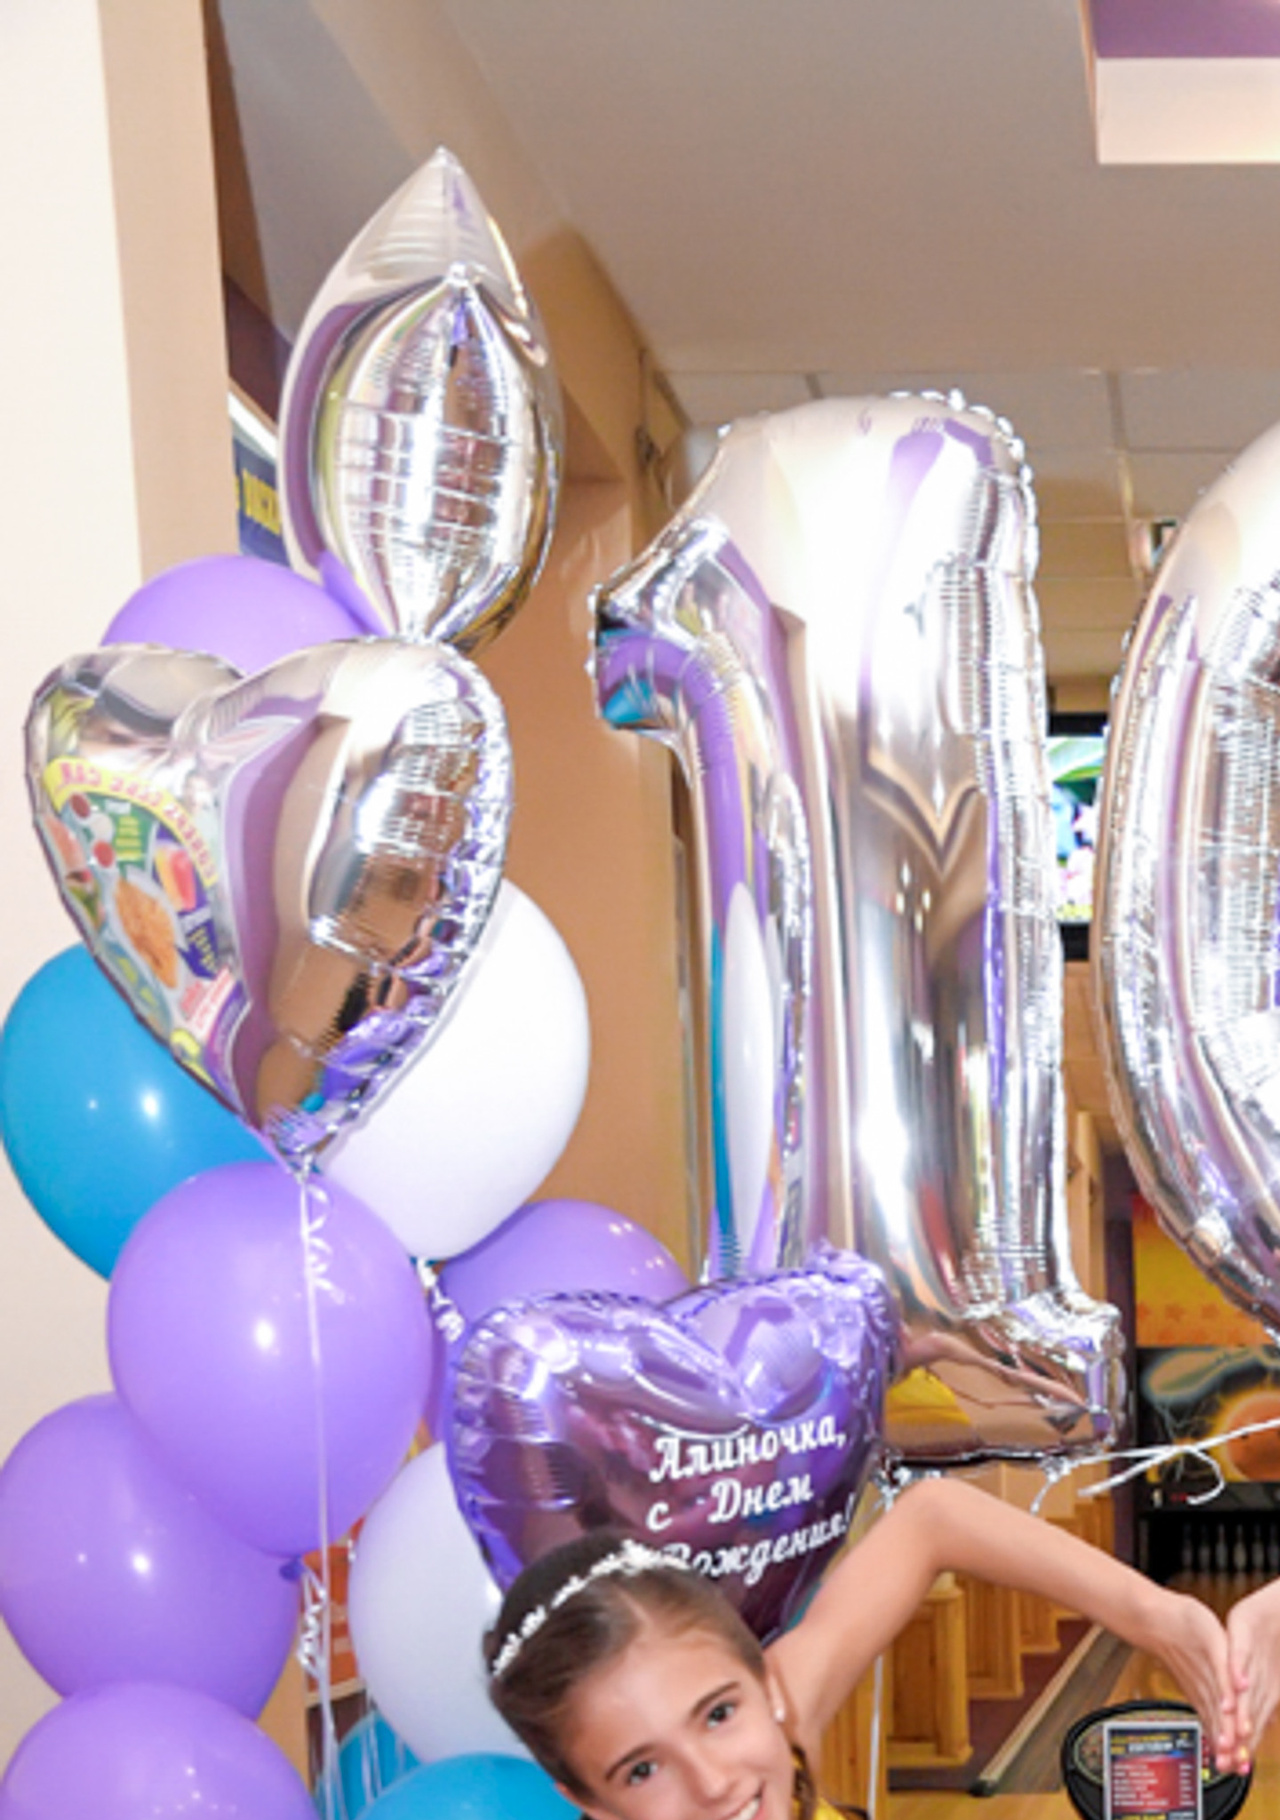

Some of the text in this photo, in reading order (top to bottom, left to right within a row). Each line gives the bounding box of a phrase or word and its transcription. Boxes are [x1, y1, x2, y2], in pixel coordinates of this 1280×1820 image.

[649, 1415, 847, 1483] Алиночка,
[645, 1474, 814, 1532] с Днем
